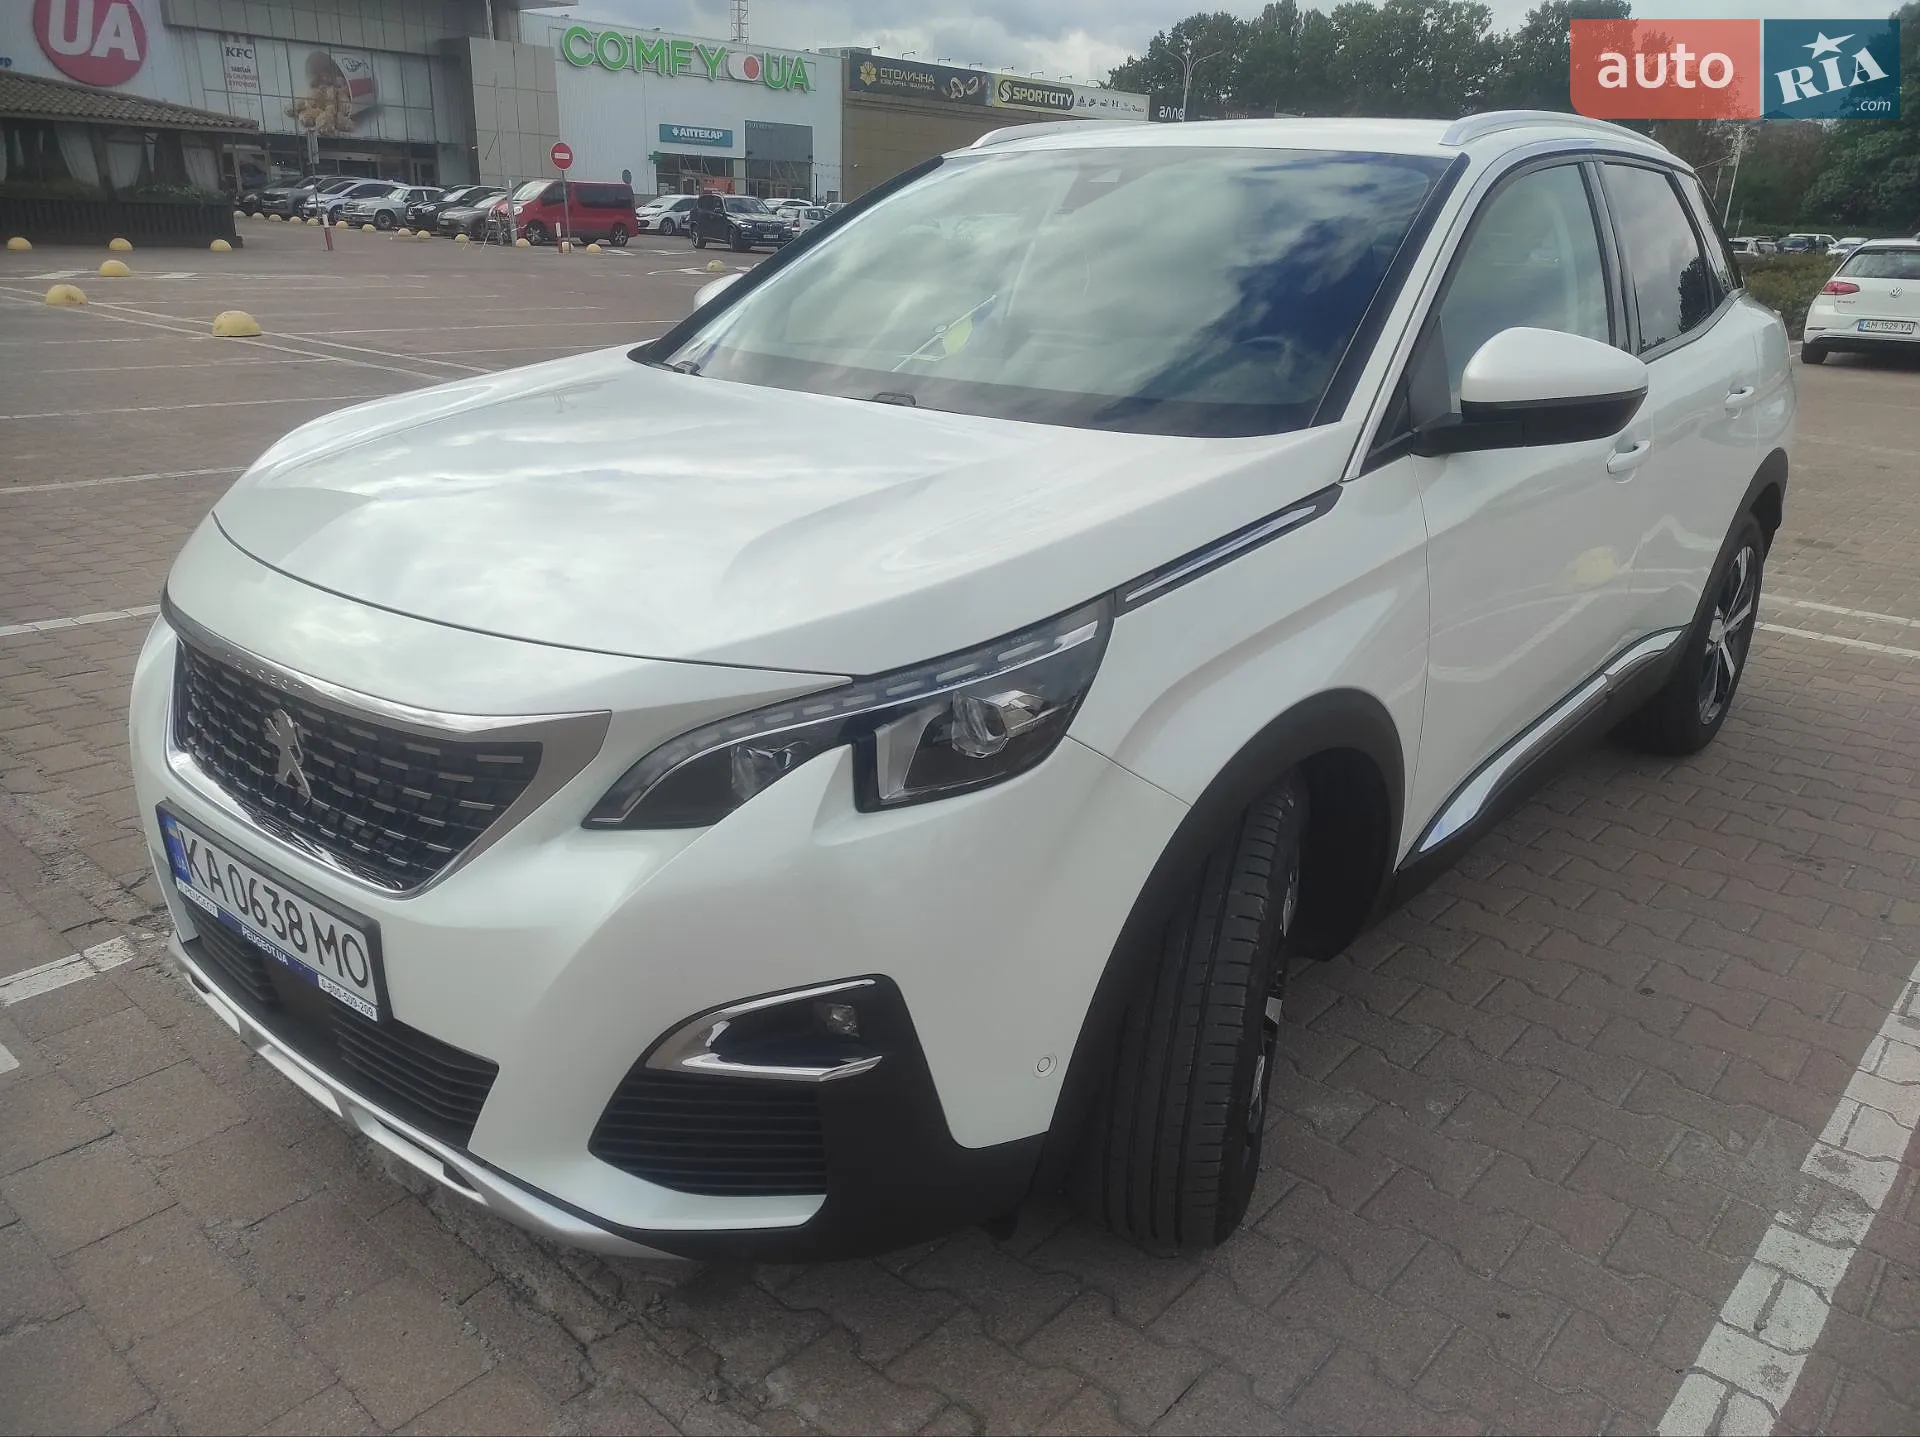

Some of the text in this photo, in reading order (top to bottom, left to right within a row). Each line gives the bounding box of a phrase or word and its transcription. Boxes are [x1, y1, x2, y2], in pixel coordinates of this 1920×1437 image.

[48, 0, 141, 61] UA
[225, 46, 253, 59] KFC
[562, 25, 811, 92] COMFY UA
[880, 67, 935, 84] СТОЛИЧНА
[1012, 87, 1073, 106] SPORTCITY
[679, 127, 723, 140] АПТЕКАР
